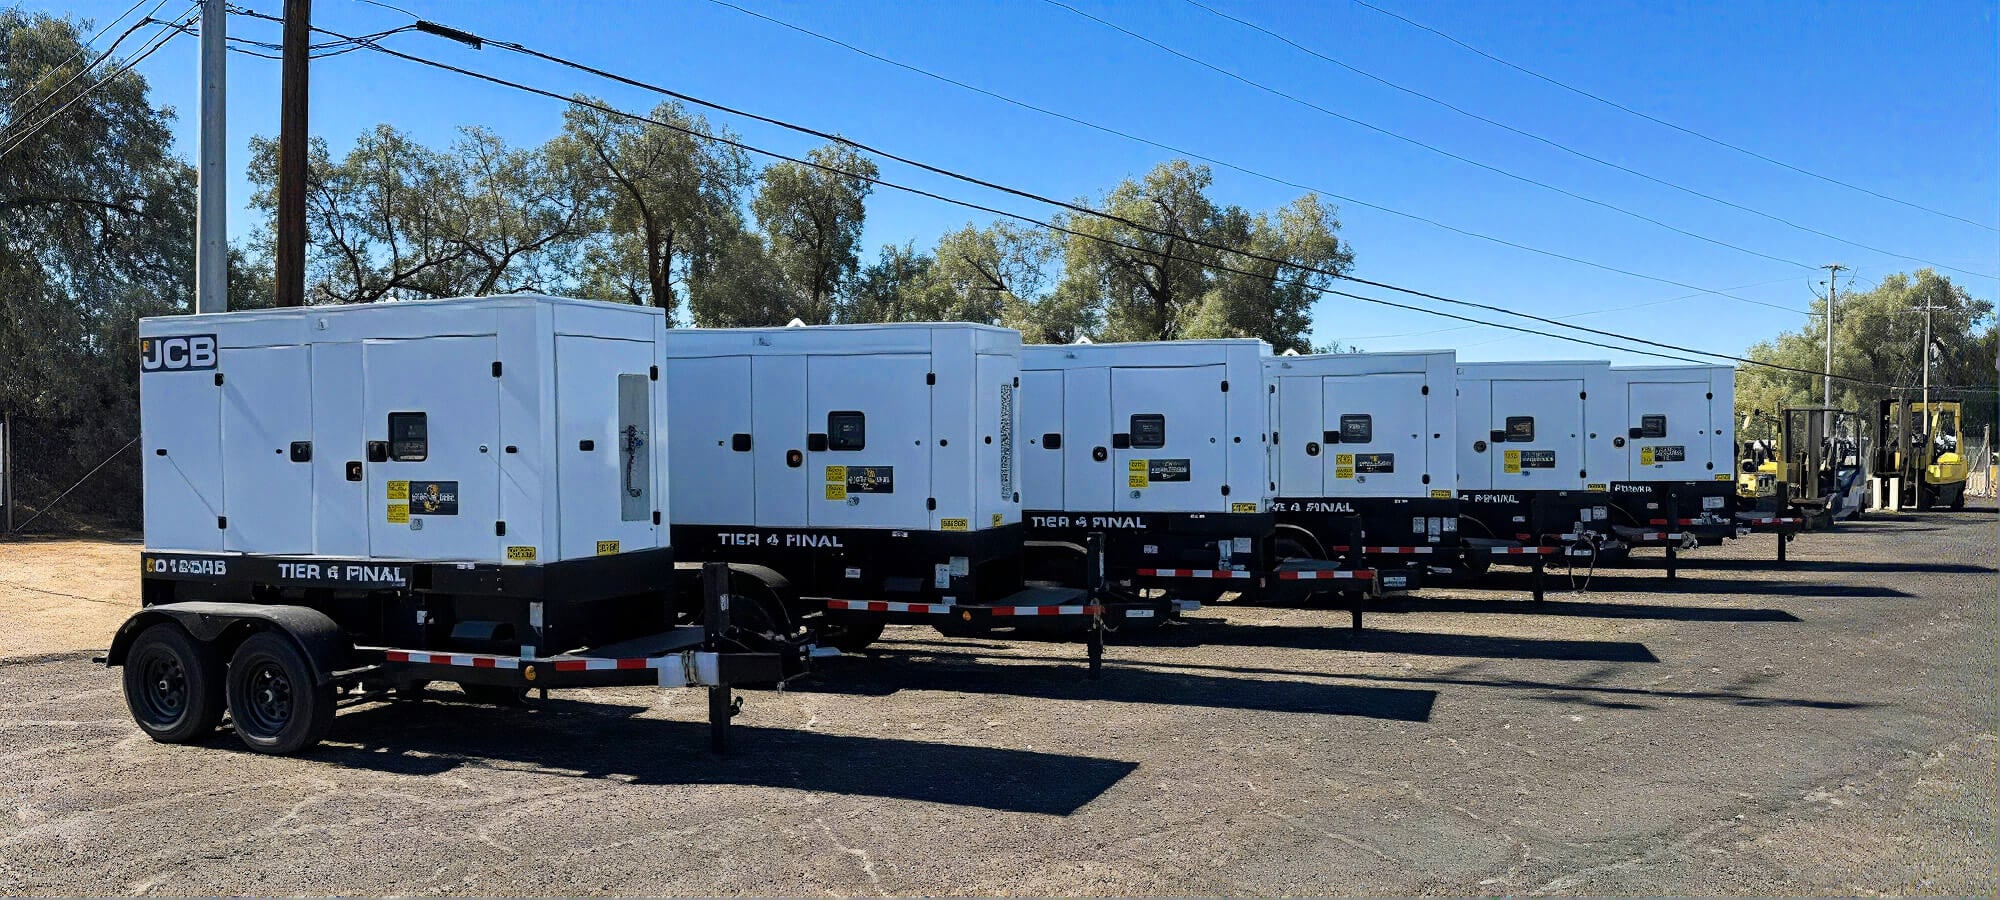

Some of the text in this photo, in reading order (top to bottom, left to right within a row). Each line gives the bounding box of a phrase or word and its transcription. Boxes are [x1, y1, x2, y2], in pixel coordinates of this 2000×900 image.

[142, 336, 216, 370] JCB
[718, 533, 760, 546] TIER
[786, 534, 843, 548] FINAL
[278, 563, 321, 579] TIER
[346, 566, 406, 583] FINAL
